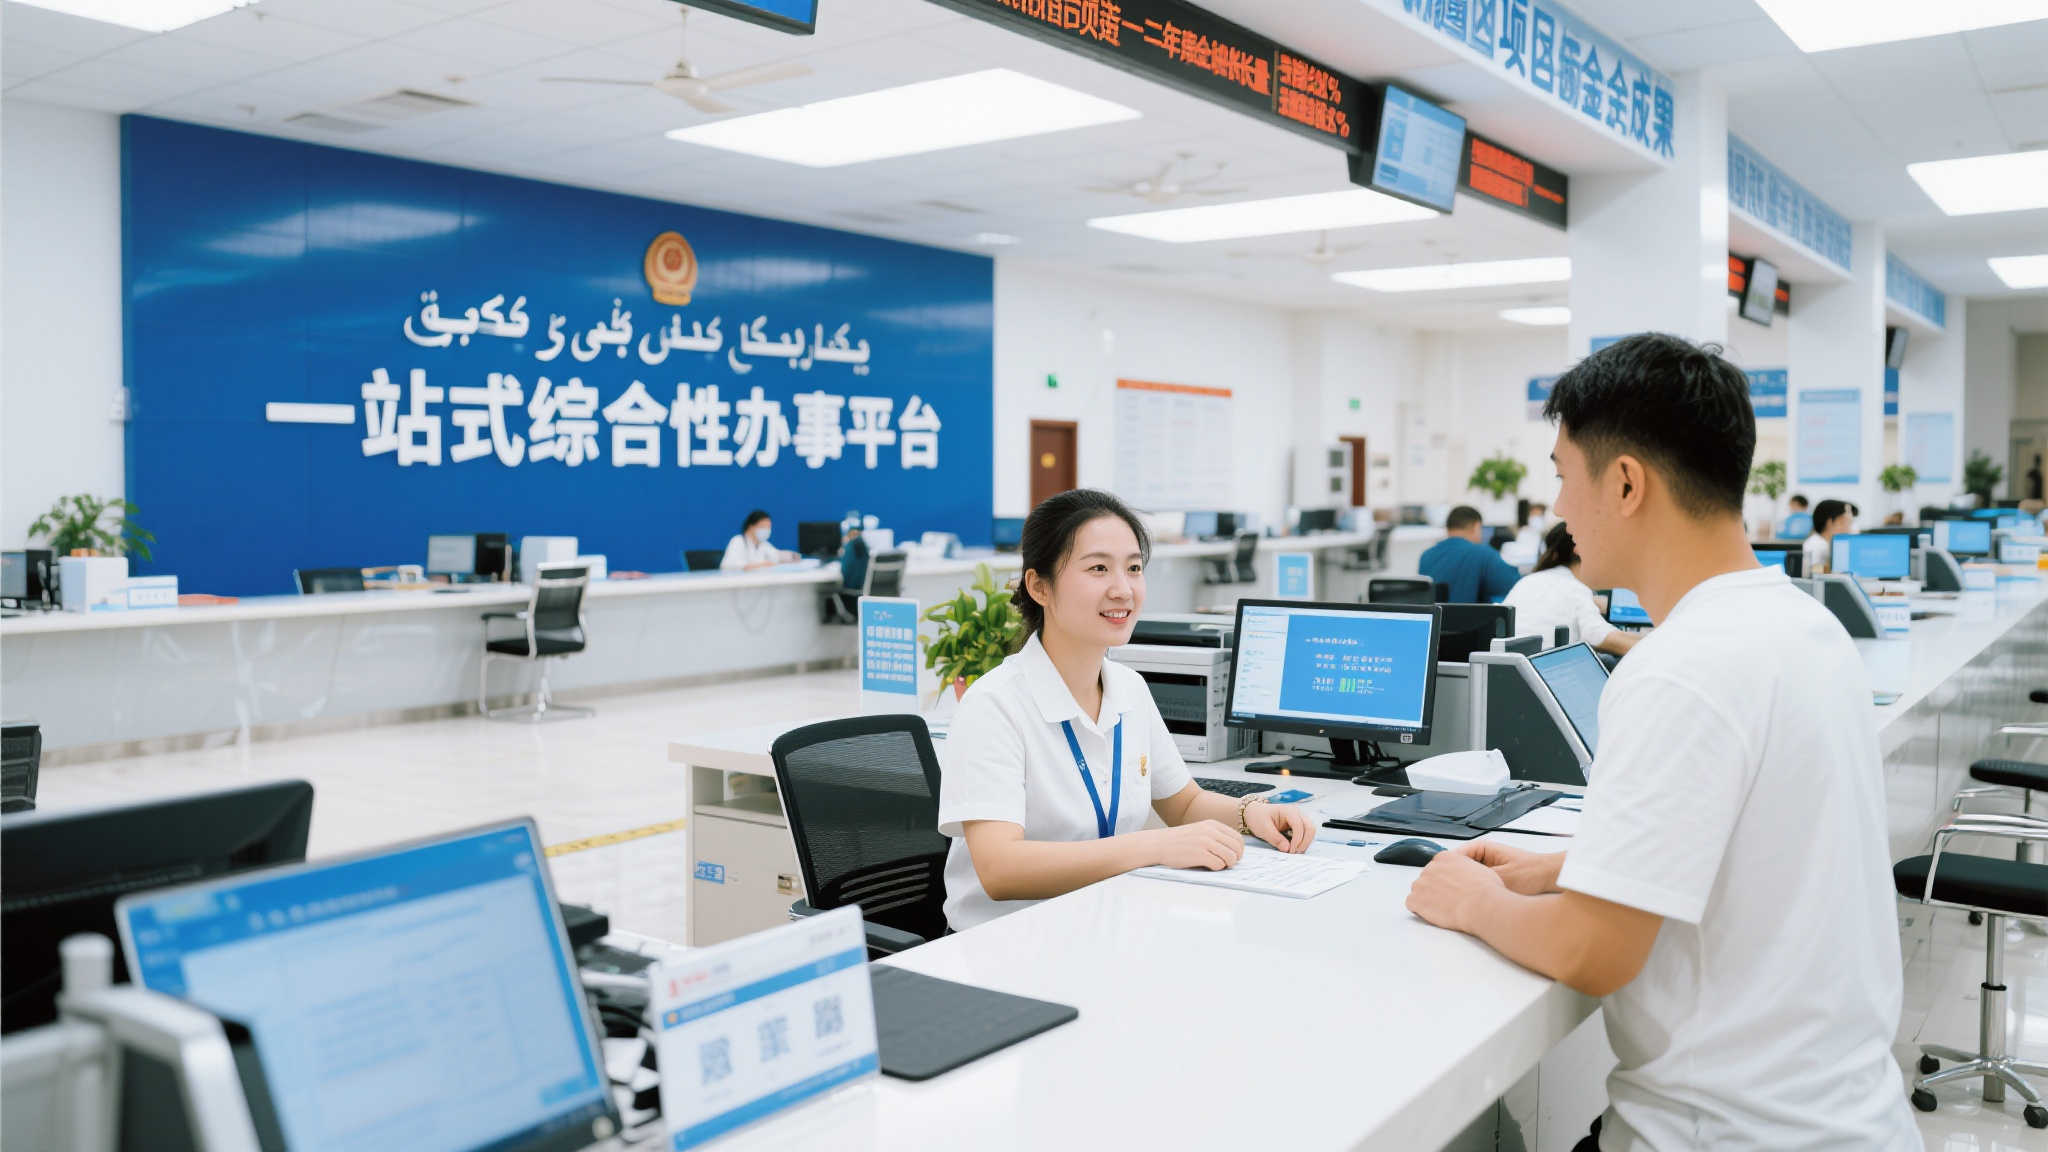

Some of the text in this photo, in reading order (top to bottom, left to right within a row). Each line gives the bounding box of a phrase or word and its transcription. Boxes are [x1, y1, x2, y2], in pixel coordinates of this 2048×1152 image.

[266, 366, 942, 469] 一站式综合性办事平台
